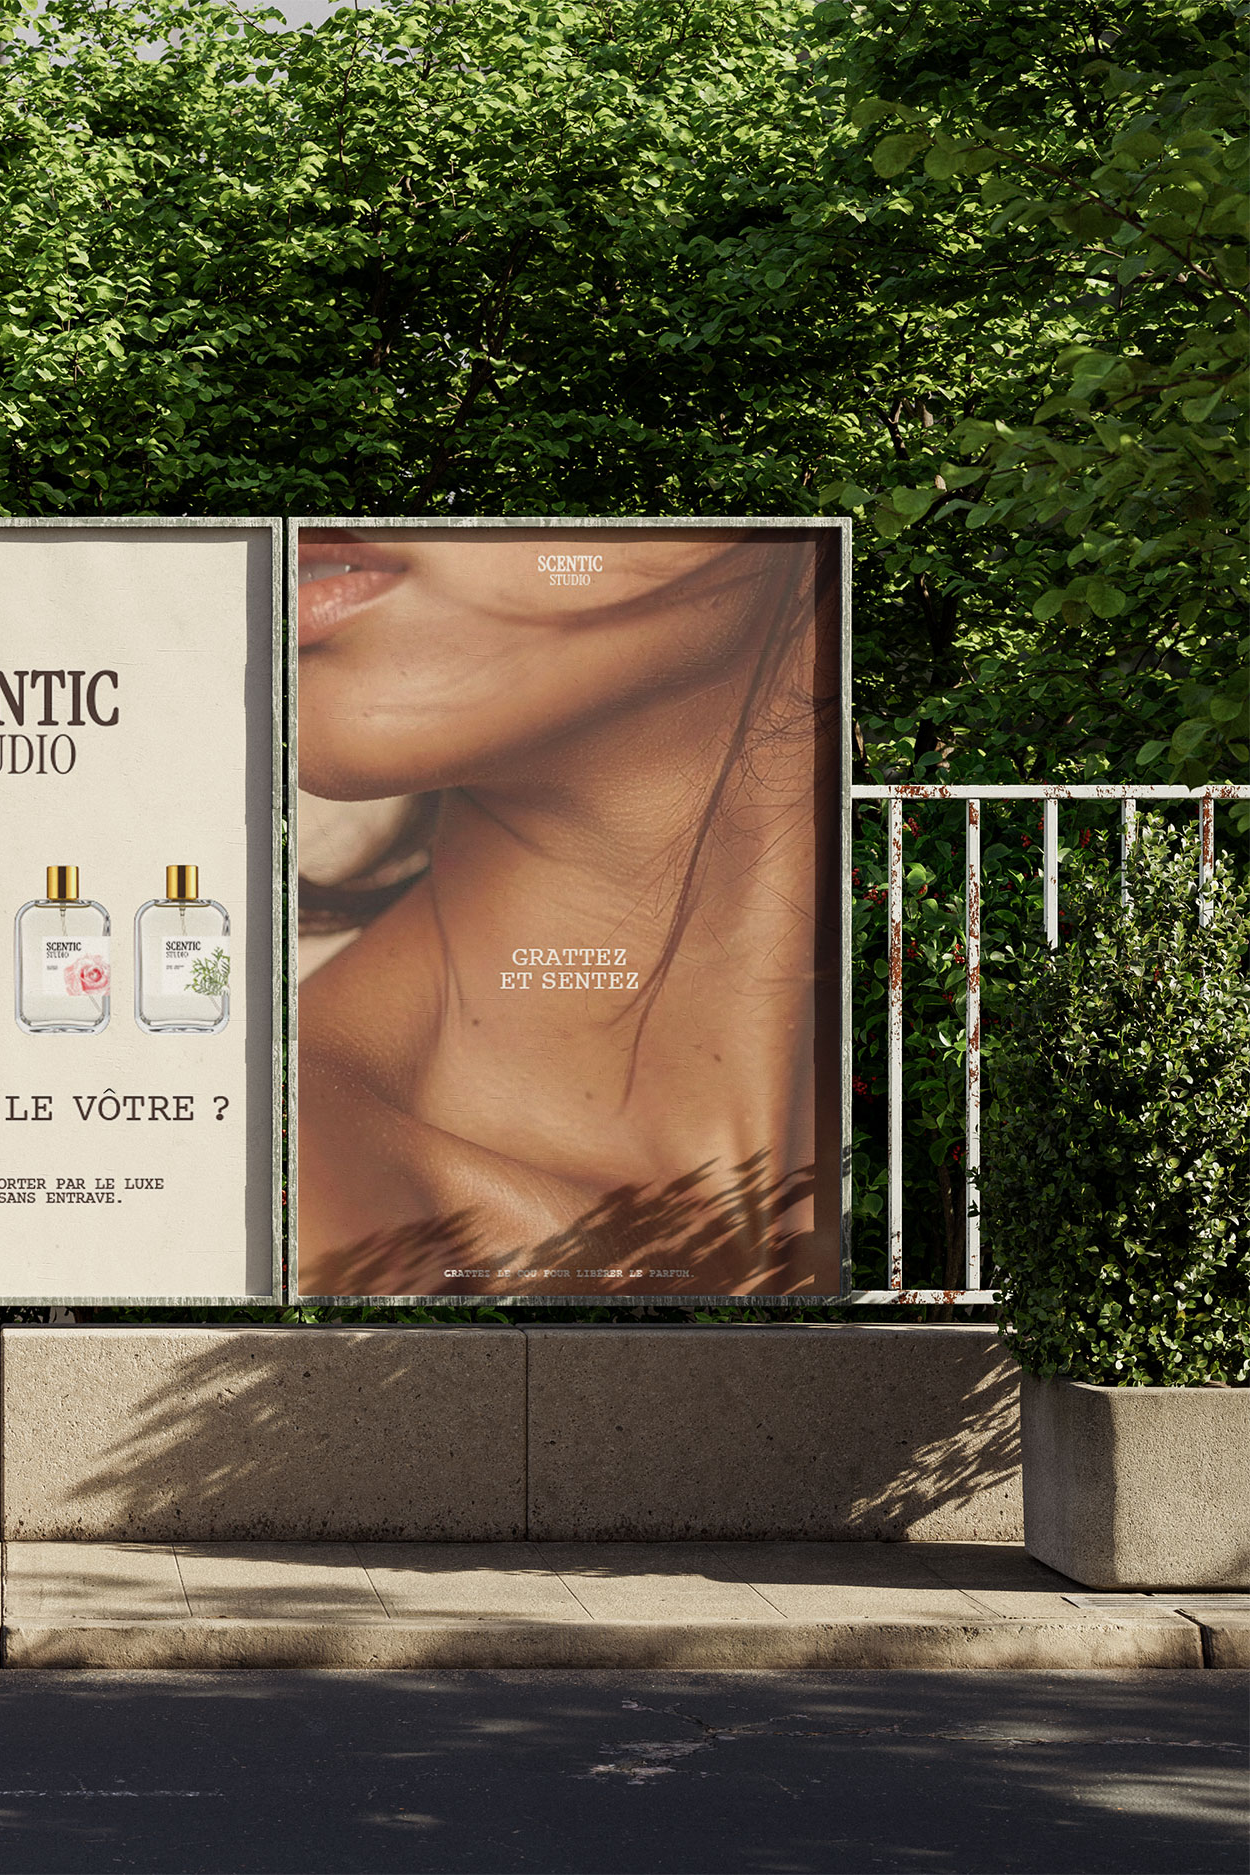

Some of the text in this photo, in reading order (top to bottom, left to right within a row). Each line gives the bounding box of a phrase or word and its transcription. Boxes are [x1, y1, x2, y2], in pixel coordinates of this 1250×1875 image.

[537, 555, 603, 573] SCENTIC
[549, 574, 591, 586] STUDIO
[46, 942, 82, 951] SCENTIC
[166, 941, 201, 951] SCENTIC
[512, 949, 627, 966] GRATTEZ
[500, 972, 640, 990] ET SENTEZ
[6, 1096, 54, 1121] LE
[74, 1088, 195, 1122] VÔTRE
[213, 1095, 230, 1122] ?
[56, 1178, 86, 1190] PAR
[95, 1178, 115, 1190] LE
[124, 1178, 164, 1190] LUXE
[46, 1192, 123, 1205] ENTRAVE.
[444, 1269, 490, 1278] GRATTEZ
[497, 1269, 511, 1278] LE
[517, 1269, 537, 1278] COU
[543, 1269, 570, 1278] POUR
[629, 1269, 643, 1278] LE
[649, 1269, 695, 1278] PARFUM.
